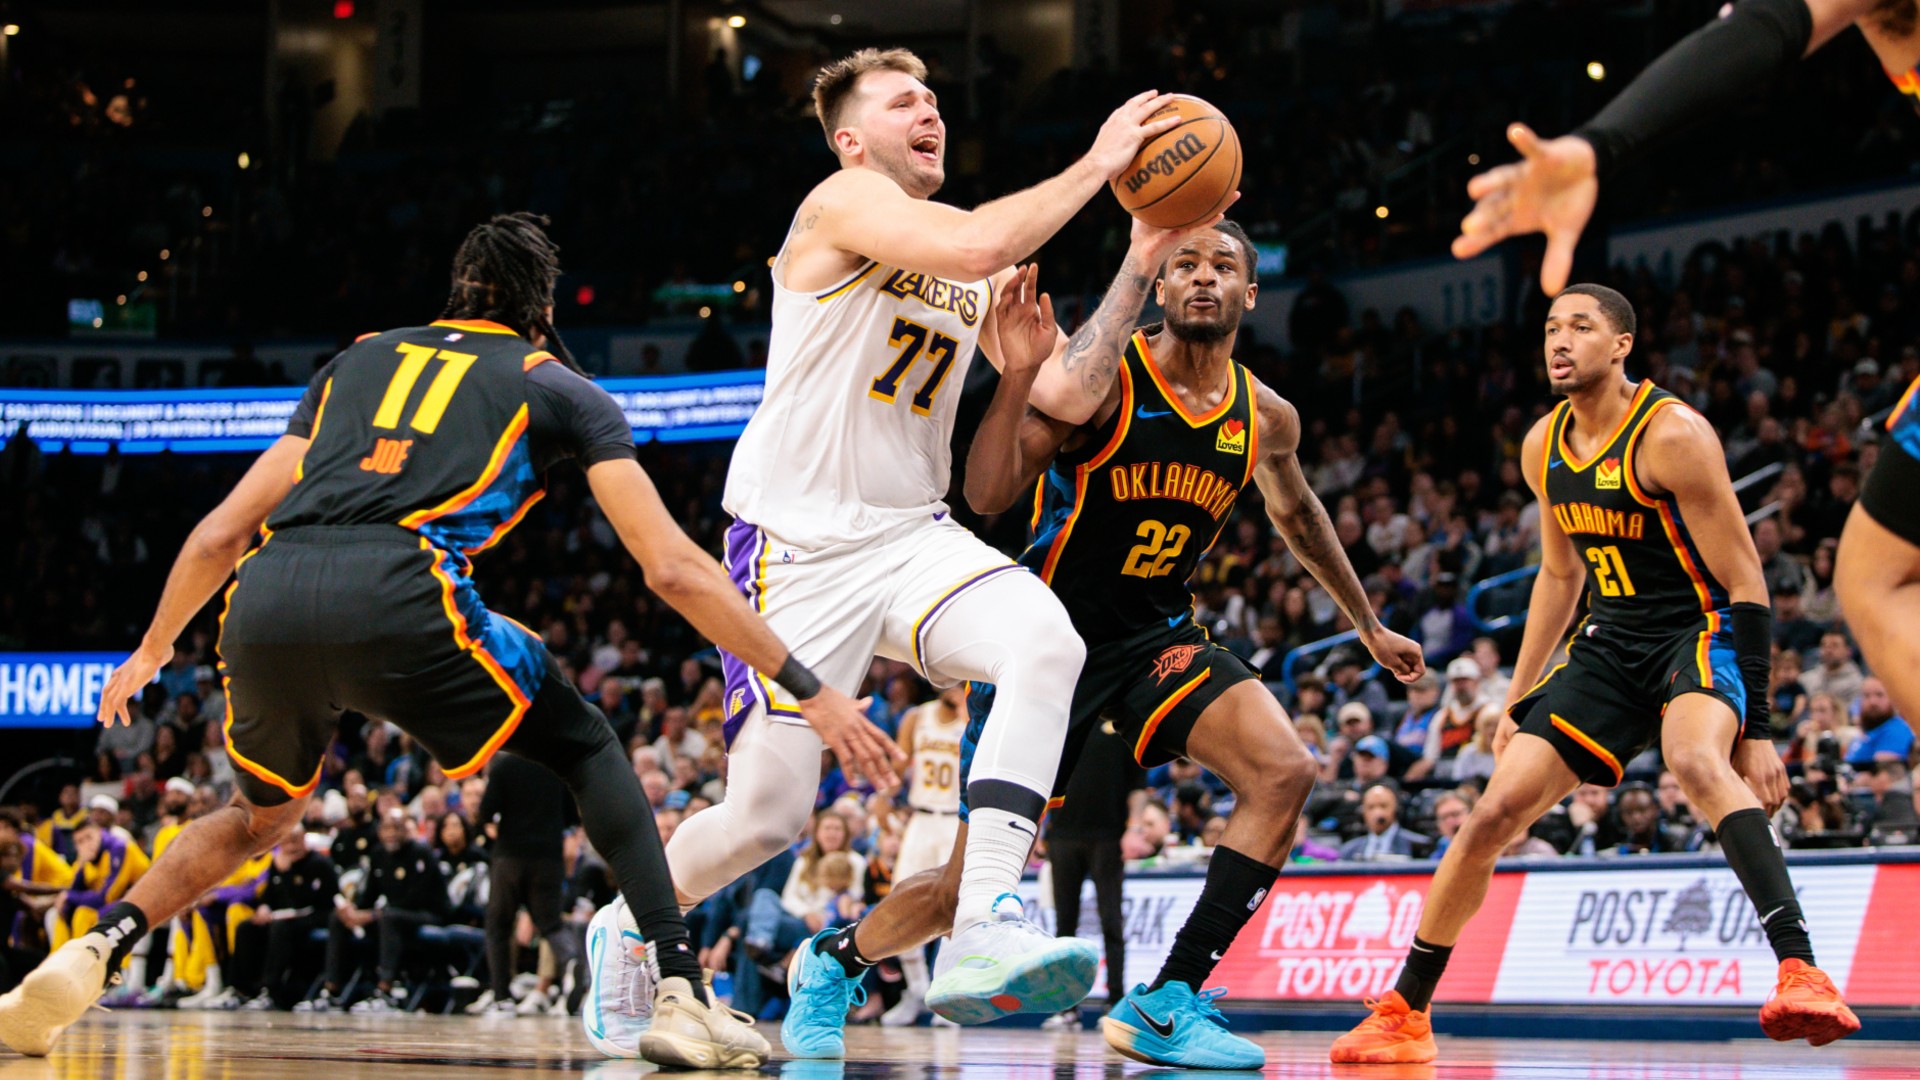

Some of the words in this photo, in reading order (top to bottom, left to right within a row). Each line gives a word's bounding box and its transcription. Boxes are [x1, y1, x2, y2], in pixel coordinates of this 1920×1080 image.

[1124, 132, 1207, 194] Wilson
[1443, 274, 1501, 325] 113
[372, 341, 479, 435] 11
[868, 315, 960, 417] 77
[359, 438, 414, 474] JOE
[1217, 439, 1243, 453] Love's
[1110, 461, 1239, 521] OKLAHOMA
[1597, 477, 1619, 487] Love's
[1121, 519, 1191, 578] 22
[1586, 545, 1636, 597] 21
[1161, 649, 1185, 675] OKC
[922, 760, 953, 792] 30
[1260, 891, 1354, 949] POST
[1568, 890, 1668, 944] POST
[1588, 959, 1741, 995] TOYOTA
